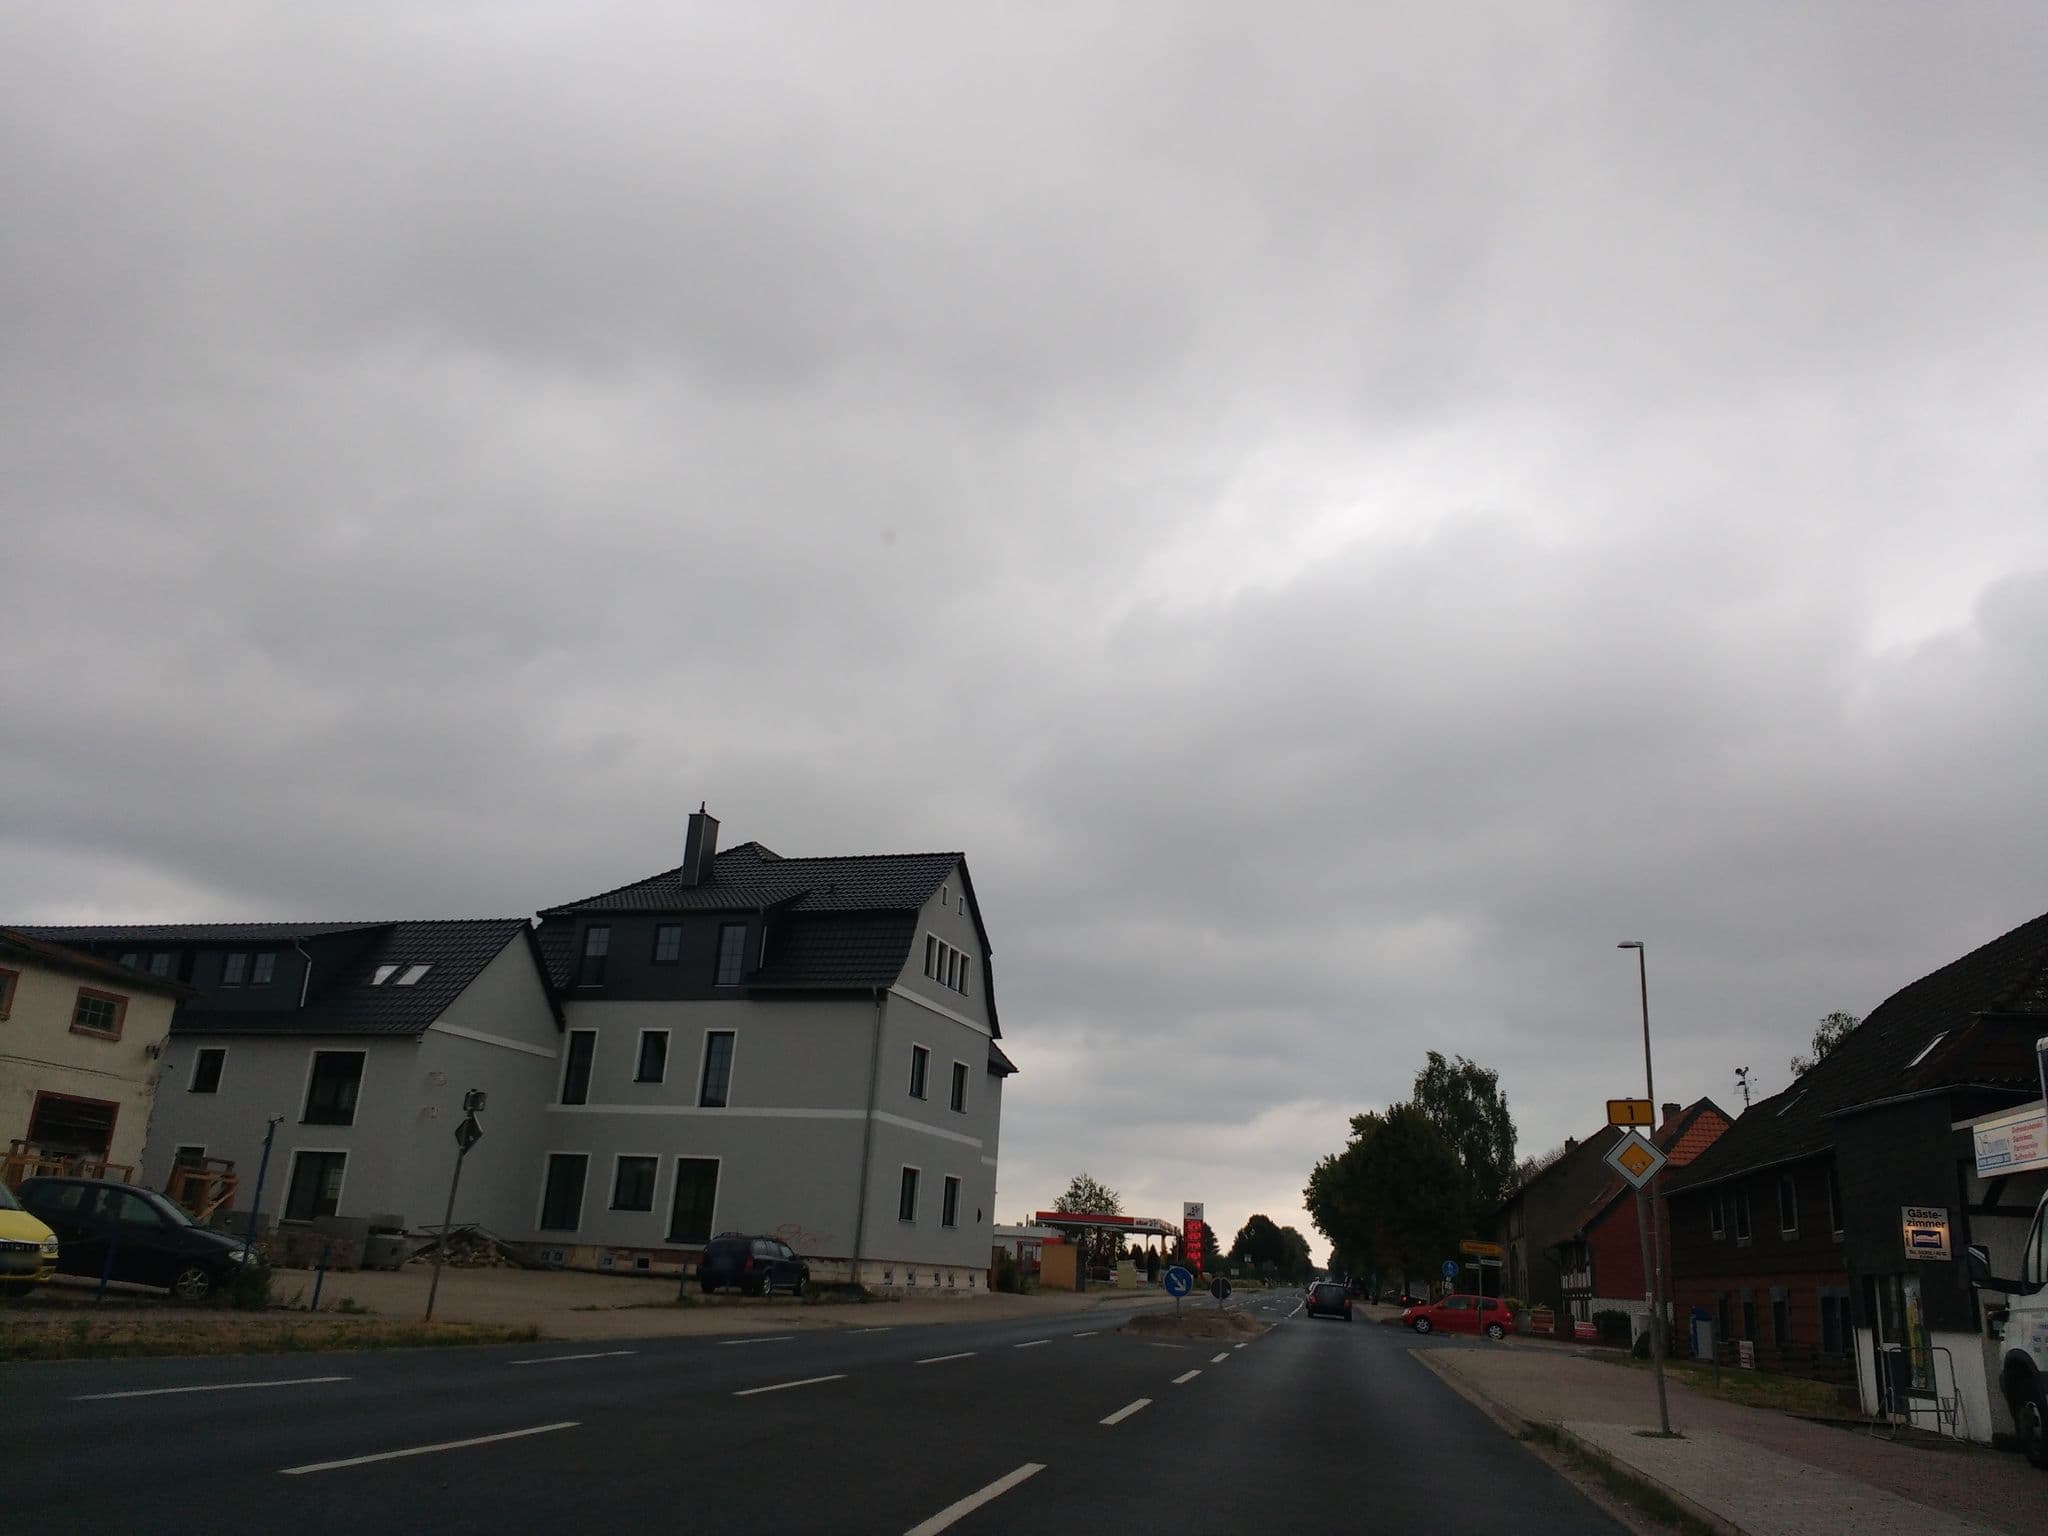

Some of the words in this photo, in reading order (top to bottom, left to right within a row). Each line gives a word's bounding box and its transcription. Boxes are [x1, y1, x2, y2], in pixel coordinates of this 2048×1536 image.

[1627, 1105, 1634, 1120] 1
[1908, 1208, 1942, 1219] Gäste-
[1907, 1218, 1946, 1228] zimmer
